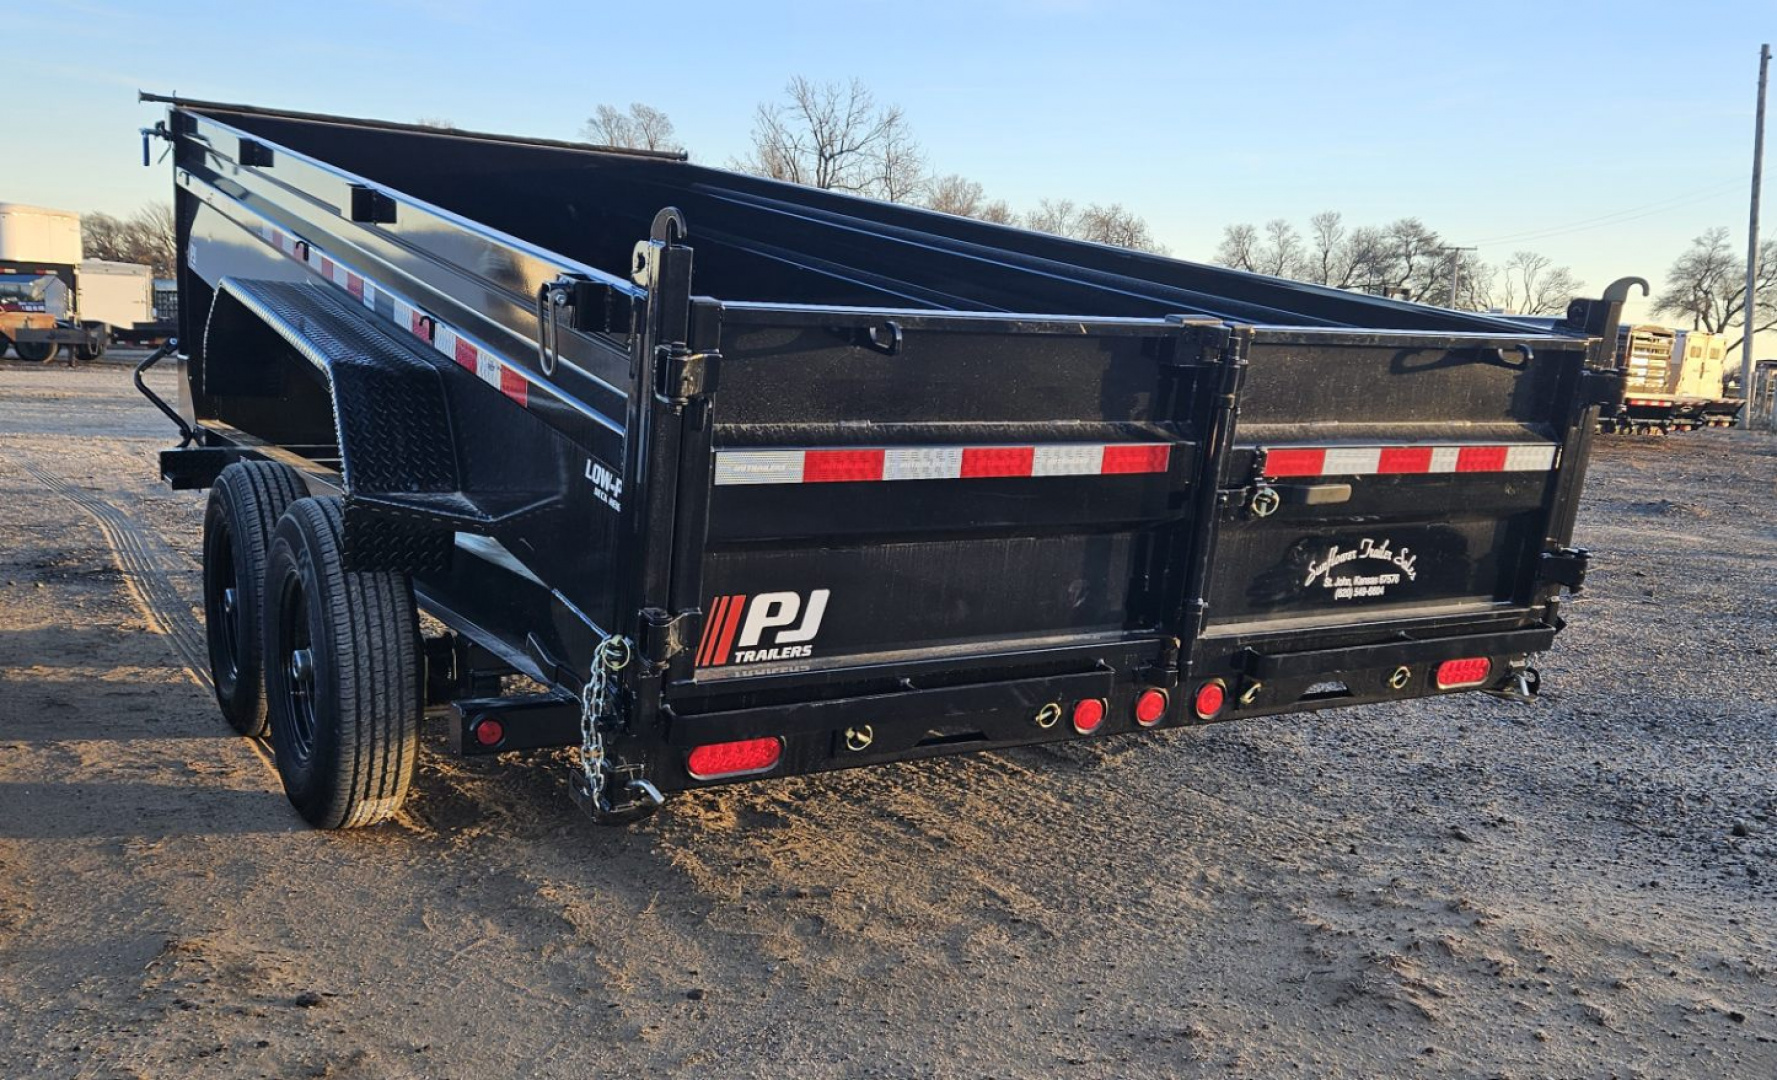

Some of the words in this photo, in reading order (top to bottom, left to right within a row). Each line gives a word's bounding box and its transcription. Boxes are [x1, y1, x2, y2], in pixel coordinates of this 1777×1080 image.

[1304, 545, 1357, 586] Sunflower
[1359, 538, 1393, 560] Trailer
[1393, 547, 1416, 580] Sales
[1353, 575, 1379, 586] Kansas
[738, 589, 830, 647] PJ
[735, 645, 812, 663] TRAILERS
